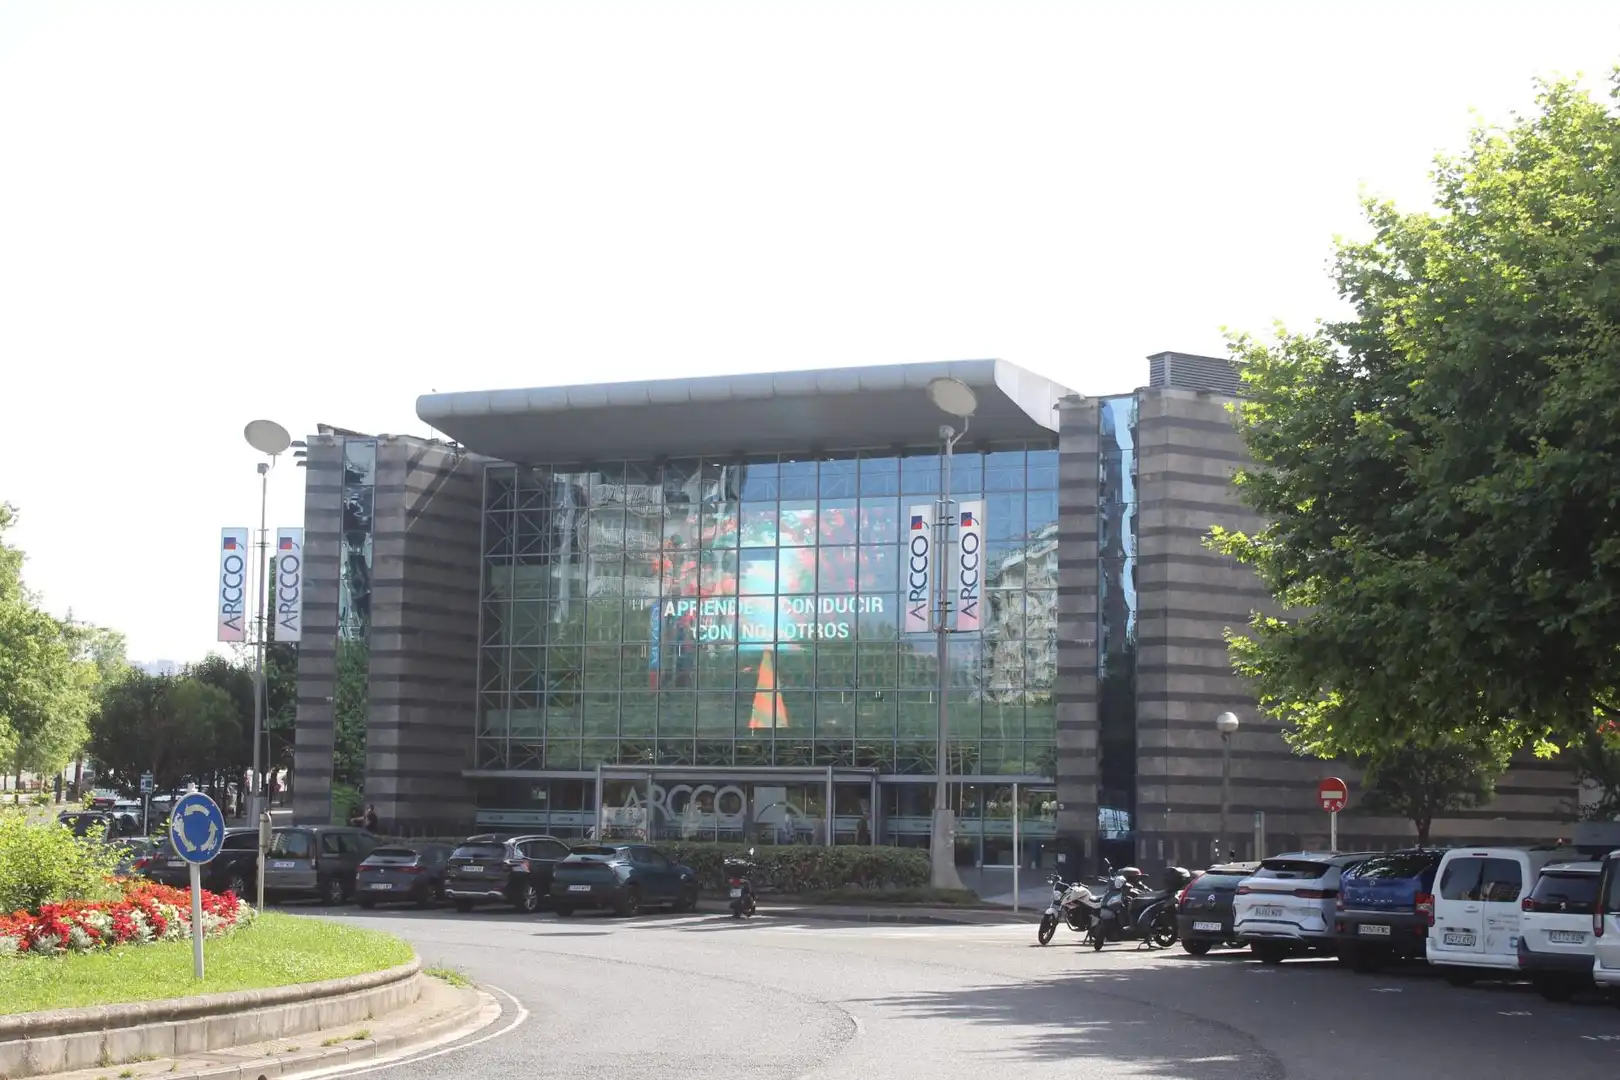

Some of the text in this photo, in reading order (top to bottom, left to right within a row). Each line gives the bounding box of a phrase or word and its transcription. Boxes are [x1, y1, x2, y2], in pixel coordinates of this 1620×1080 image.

[222, 555, 244, 632] ARCCO
[279, 555, 300, 632] ARCCO
[781, 597, 884, 614] CONDUCIR
[909, 535, 929, 621] ARCCO
[960, 532, 979, 619] ARCCO
[692, 622, 849, 640] CON NOOTROS
[621, 784, 747, 822] ARCCO
